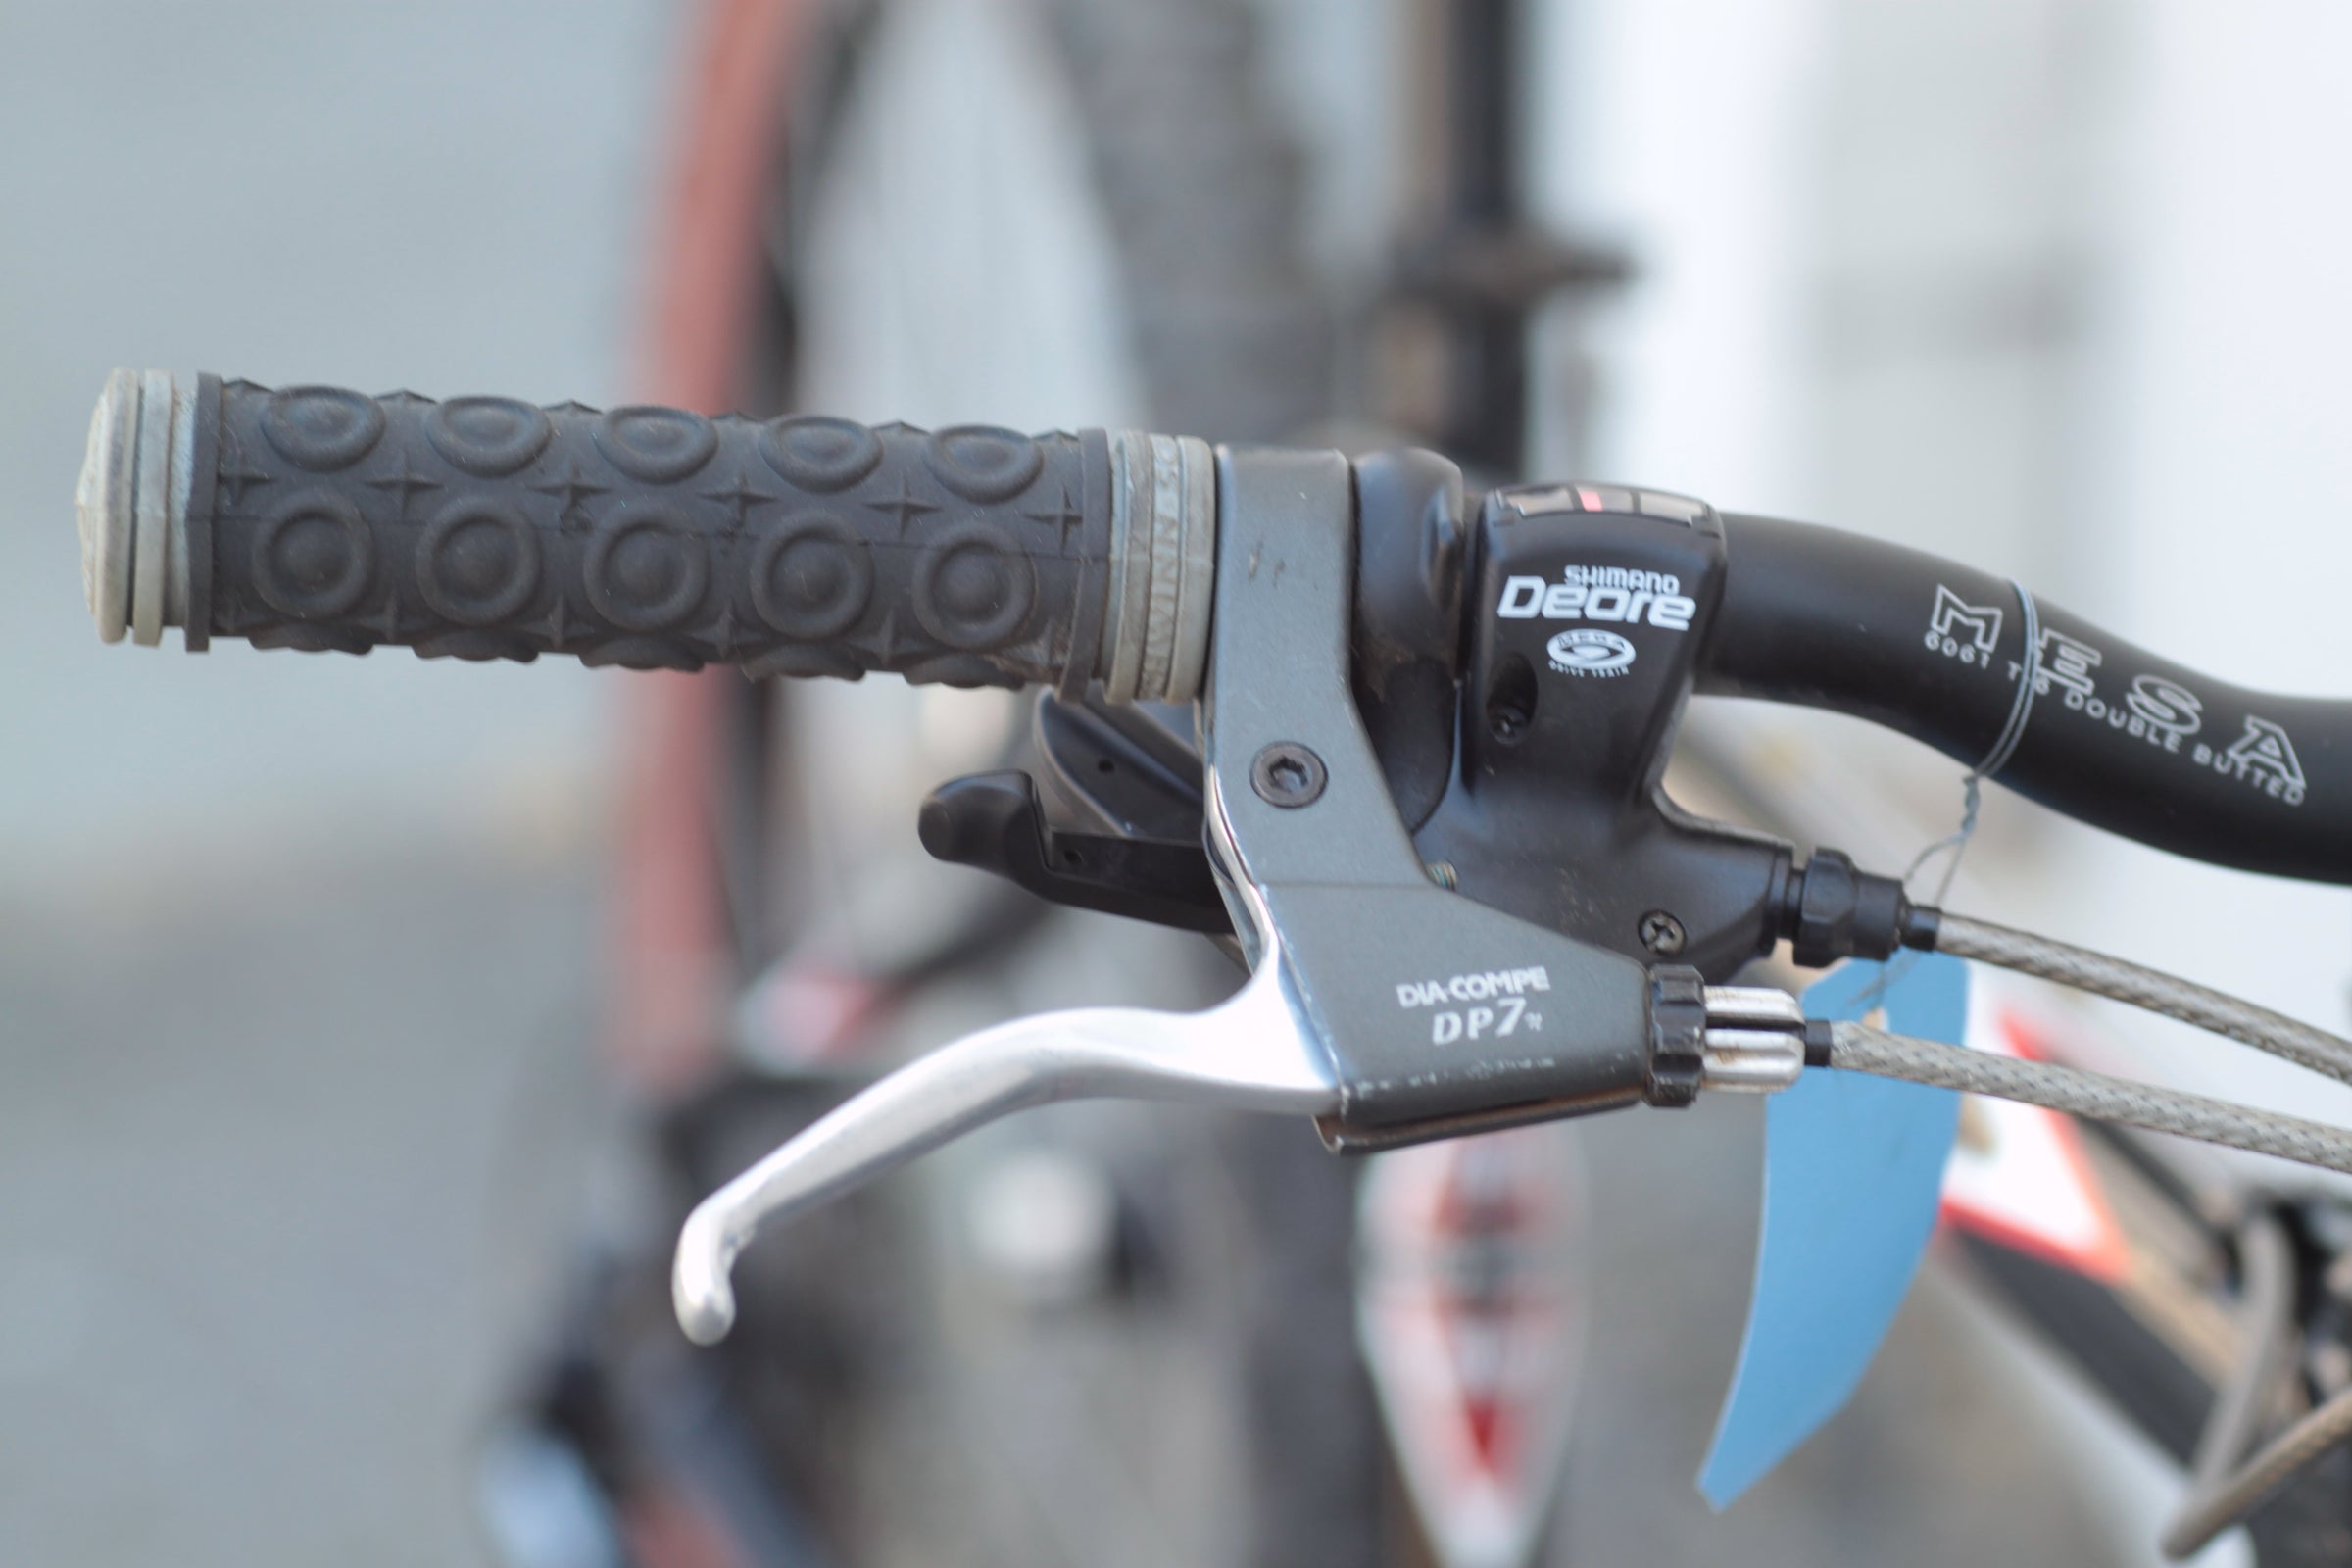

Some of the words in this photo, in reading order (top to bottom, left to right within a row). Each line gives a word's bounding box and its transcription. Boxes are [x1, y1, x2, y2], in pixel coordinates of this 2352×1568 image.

[1496, 575, 1696, 632] Deore
[1564, 564, 1680, 596] SHIMANO
[1924, 629, 1990, 670] 6061
[2064, 688, 2182, 754] DOUBLE
[2191, 742, 2305, 807] BUTTED
[1930, 583, 2307, 790] MESA
